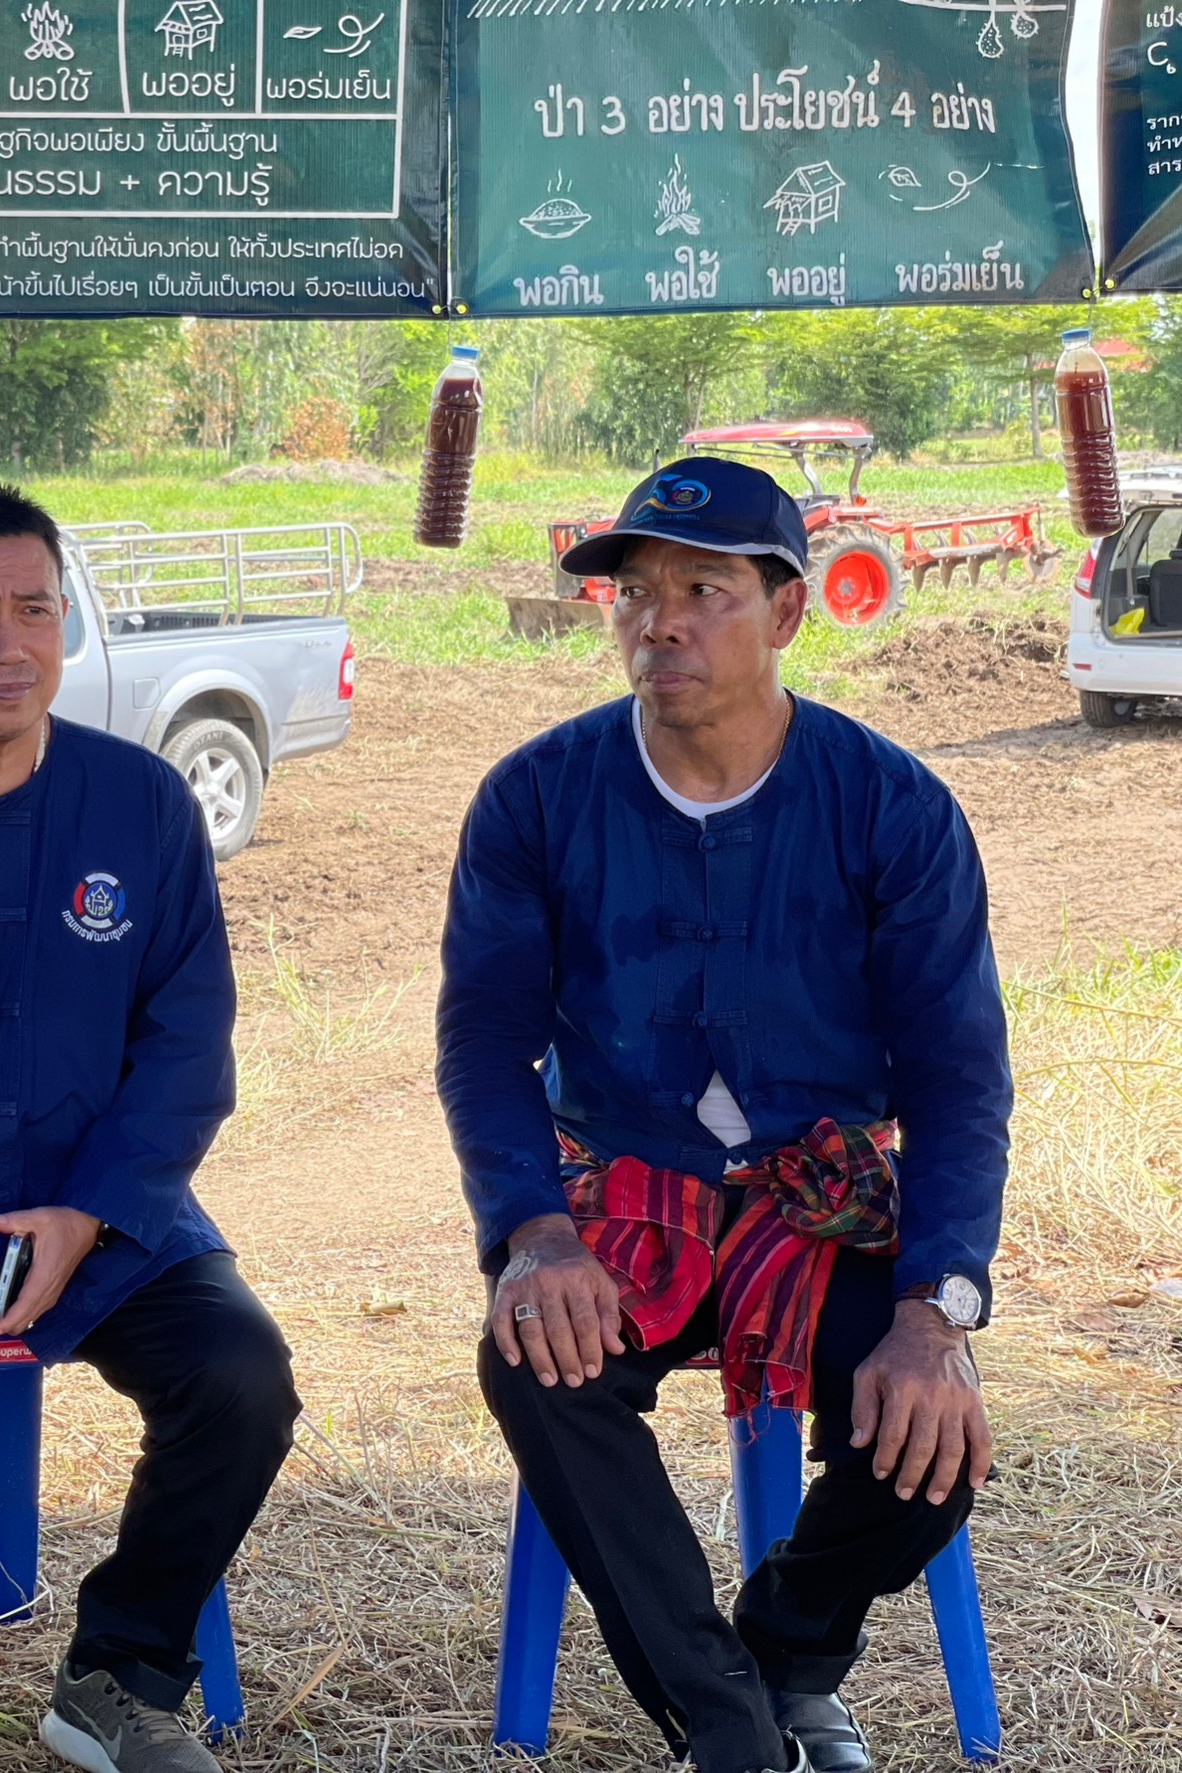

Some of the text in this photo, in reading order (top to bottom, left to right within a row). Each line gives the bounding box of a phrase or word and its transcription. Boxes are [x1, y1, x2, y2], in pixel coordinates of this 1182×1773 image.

[9, 67, 93, 102] พอใช้
[142, 64, 236, 107] พออยู่
[266, 69, 392, 100] พอร่มเย็น
[534, 59, 996, 138] ป่า 3 อย่าง ประโยชน์ 4 อย่าง
[156, 122, 278, 160] ขั้นพื้นฐาน
[119, 174, 141, 191] +
[158, 162, 274, 207] ความรู้
[227, 232, 404, 260] ให้ทั้งประเทศไม่อด
[895, 239, 1025, 293] พอร่มเย็น
[148, 271, 295, 298] เป็นขั้นเป็นตอน
[513, 265, 604, 307] พอกิน
[644, 245, 720, 304] พอใช้
[767, 252, 846, 307] พออยู่
